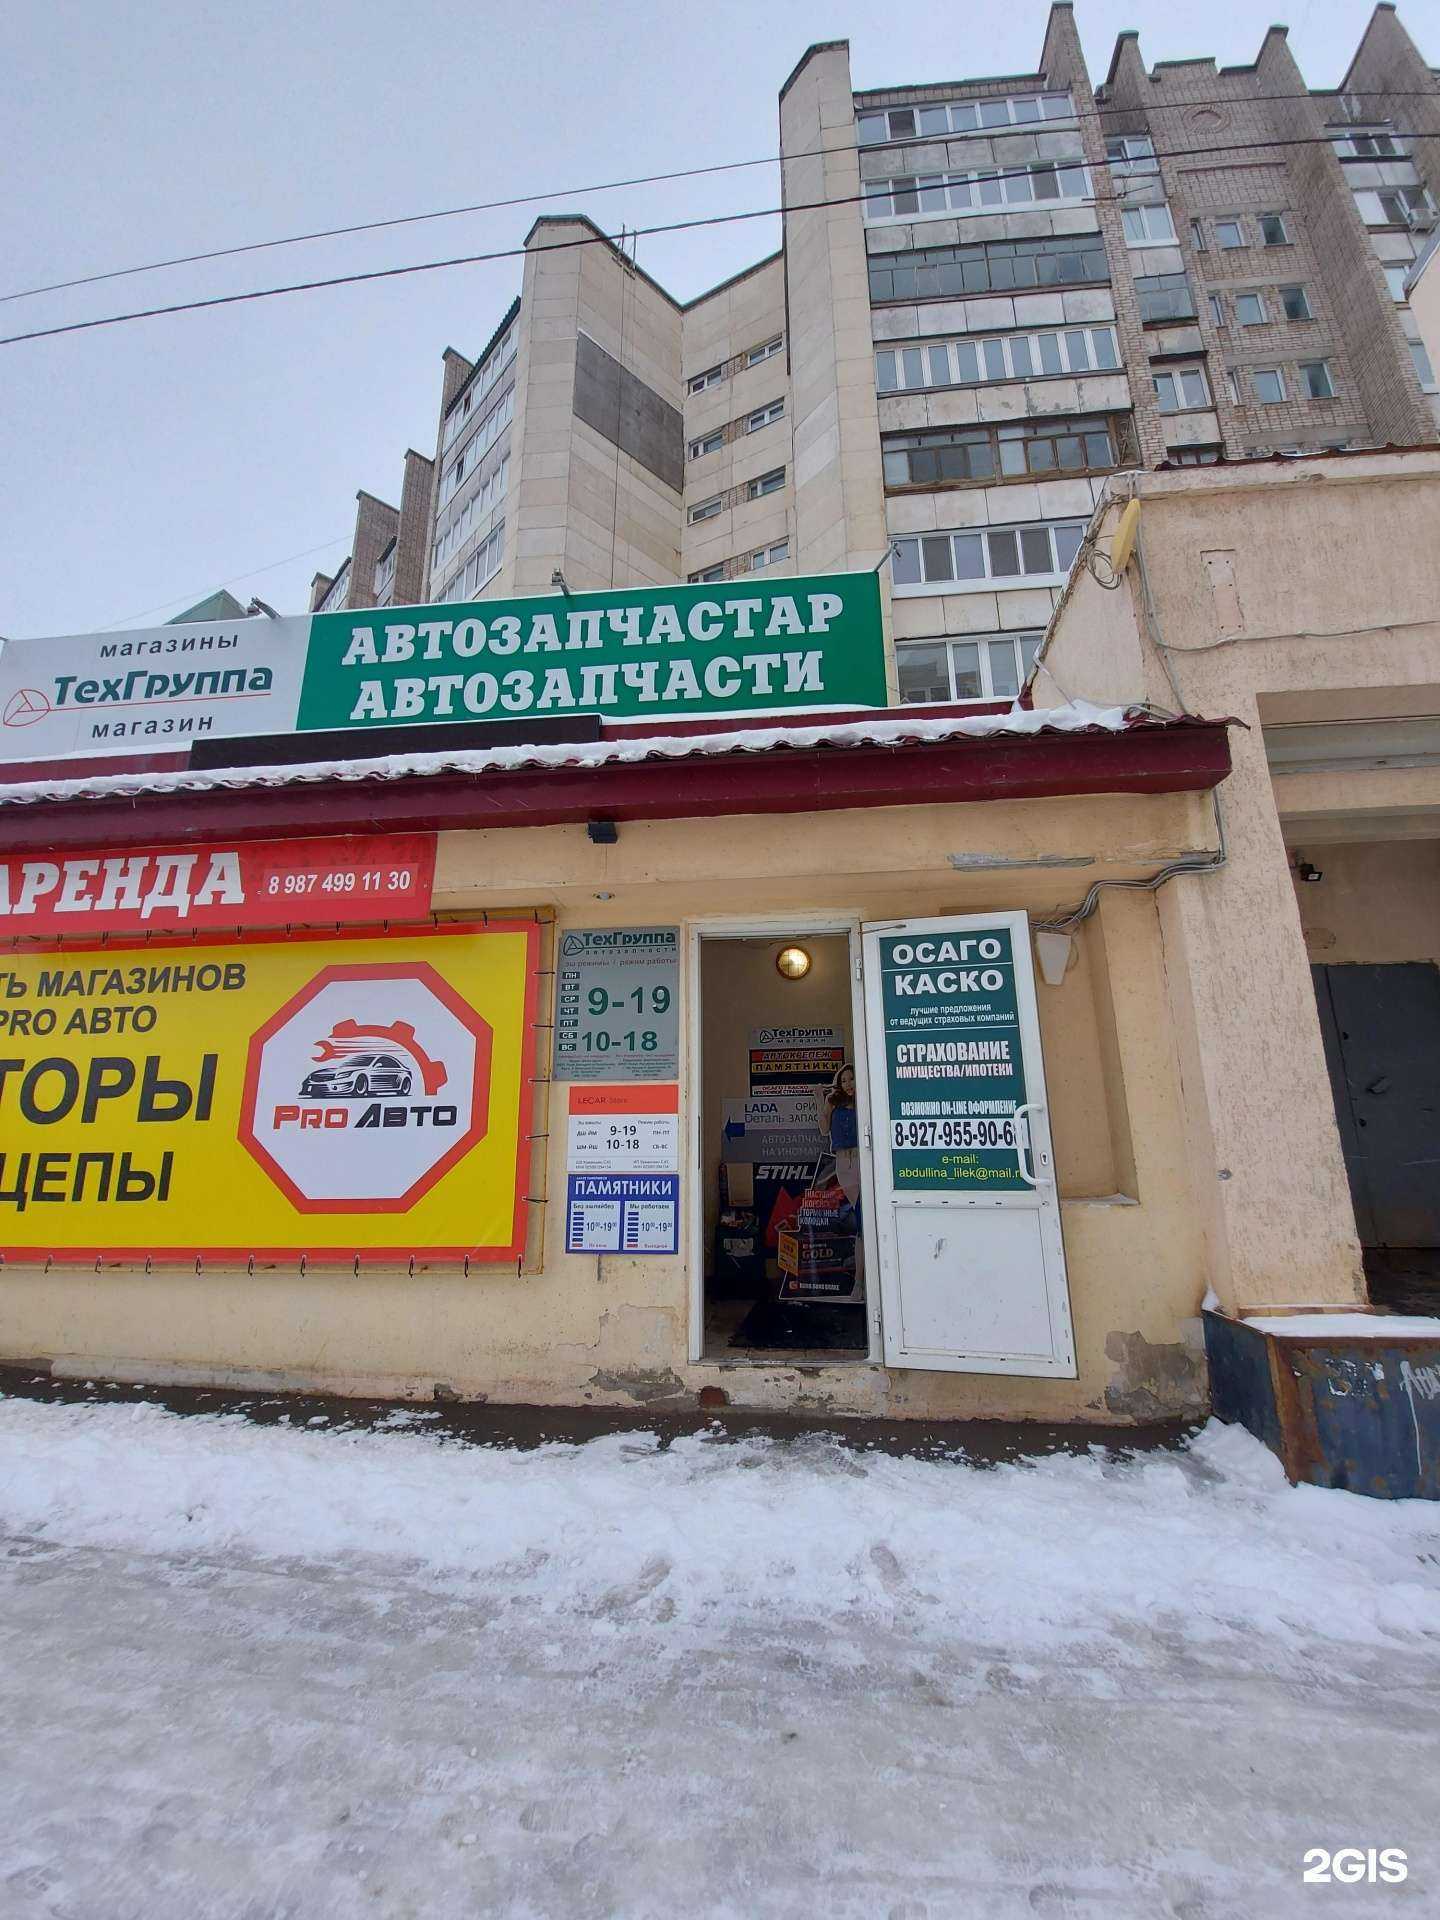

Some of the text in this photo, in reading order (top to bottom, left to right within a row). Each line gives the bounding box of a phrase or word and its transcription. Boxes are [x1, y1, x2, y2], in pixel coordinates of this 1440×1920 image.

[341, 592, 844, 667] АВТОЗАПЧАСТАР
[100, 632, 240, 659] магазины
[54, 664, 274, 706] ТехГруппа
[349, 650, 825, 721] АВТОЗАПЧАСТИ
[91, 714, 213, 740] магазин
[0, 852, 245, 919] РЕНДА
[268, 870, 411, 894] 8 987 499 11 30
[582, 932, 676, 946] ТехГруппа
[892, 938, 1002, 965] ОСАГО
[37, 963, 247, 998] МАГАЗИНОВ
[565, 972, 577, 980] ПН
[894, 969, 1004, 996] КАСКО
[910, 1003, 991, 1016] лучшие предложения
[63, 1005, 158, 1035] АВТО
[890, 1011, 1015, 1026] от ведущих страховых компаний
[581, 1031, 658, 1051] 10-18
[772, 1028, 833, 1038] ТехГруппа
[896, 1040, 1010, 1063] СТРАХОВАНИЕ
[755, 1062, 839, 1072] ПАМЯТНИКИ
[896, 1063, 1013, 1080] ИМУЩЕСТВА/ИПОТЕКИ
[577, 1096, 606, 1105] LECAR
[744, 1103, 778, 1113] LADA
[901, 1100, 1016, 1117] ВОЗМОЖНО ON-LINE ОФОРМЛЕНИЕ
[609, 1125, 637, 1136] 9-19
[895, 1120, 1018, 1147] 8-927-955-90-6
[606, 1139, 640, 1150] 10-18
[942, 1153, 980, 1165] e-mail:
[755, 1165, 814, 1180] STIHL
[899, 1166, 1022, 1181] abdullina_lilek@mail.r
[575, 1180, 672, 1196] ПАМЯТНИКИ
[802, 1248, 834, 1260] GOLD
